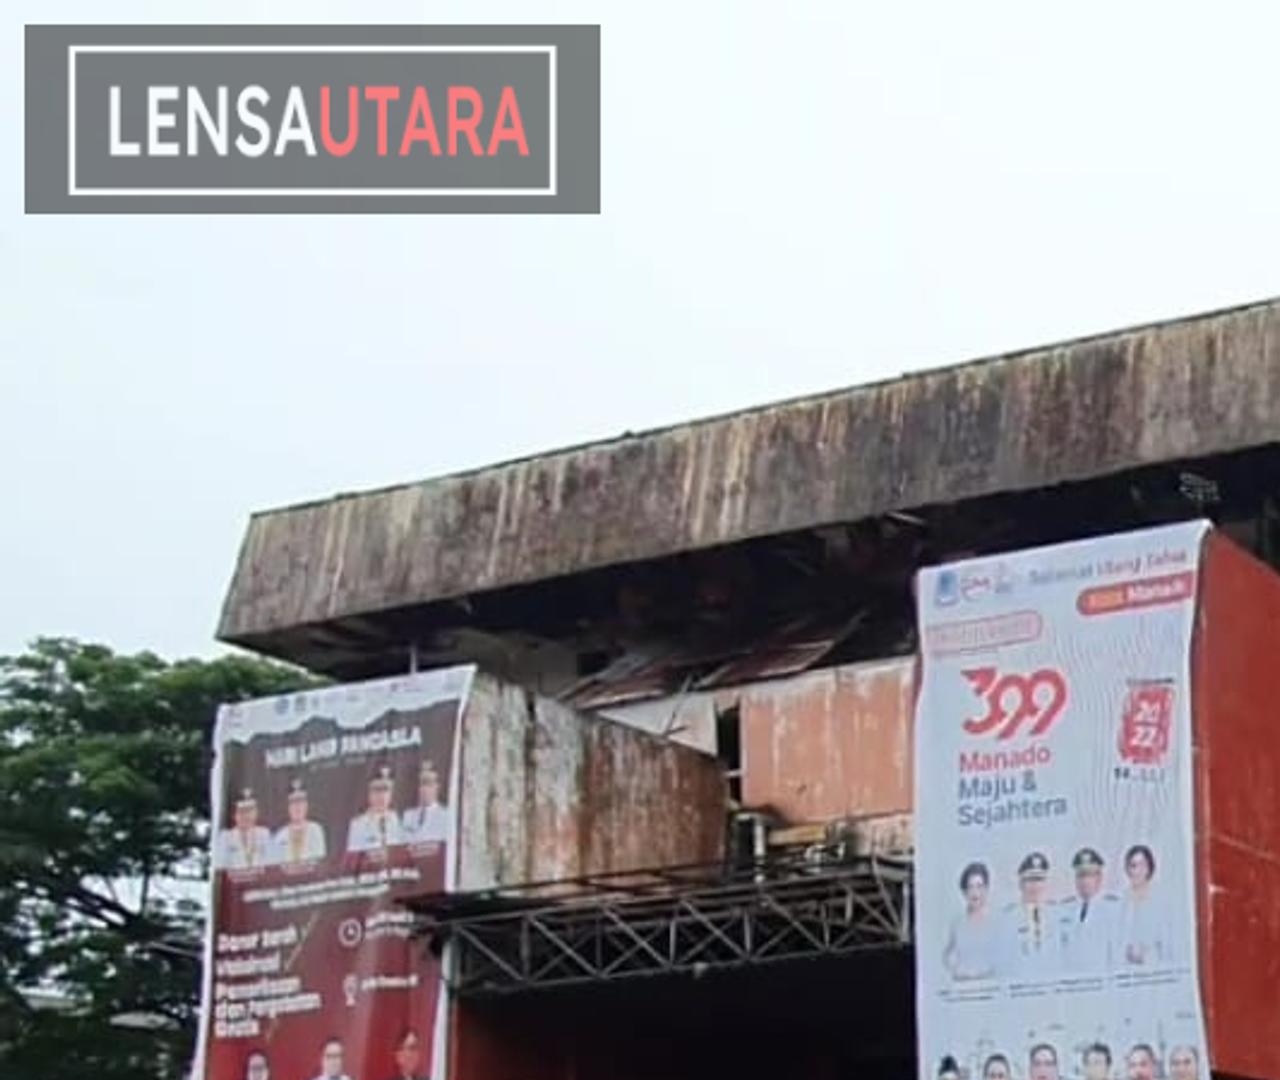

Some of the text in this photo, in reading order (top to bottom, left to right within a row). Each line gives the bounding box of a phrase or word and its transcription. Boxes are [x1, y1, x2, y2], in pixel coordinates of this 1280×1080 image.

[961, 667, 1069, 740] 399
[959, 750, 1051, 773] Manado
[959, 773, 1037, 804] Maju &
[957, 798, 1068, 828] Sejahtera
